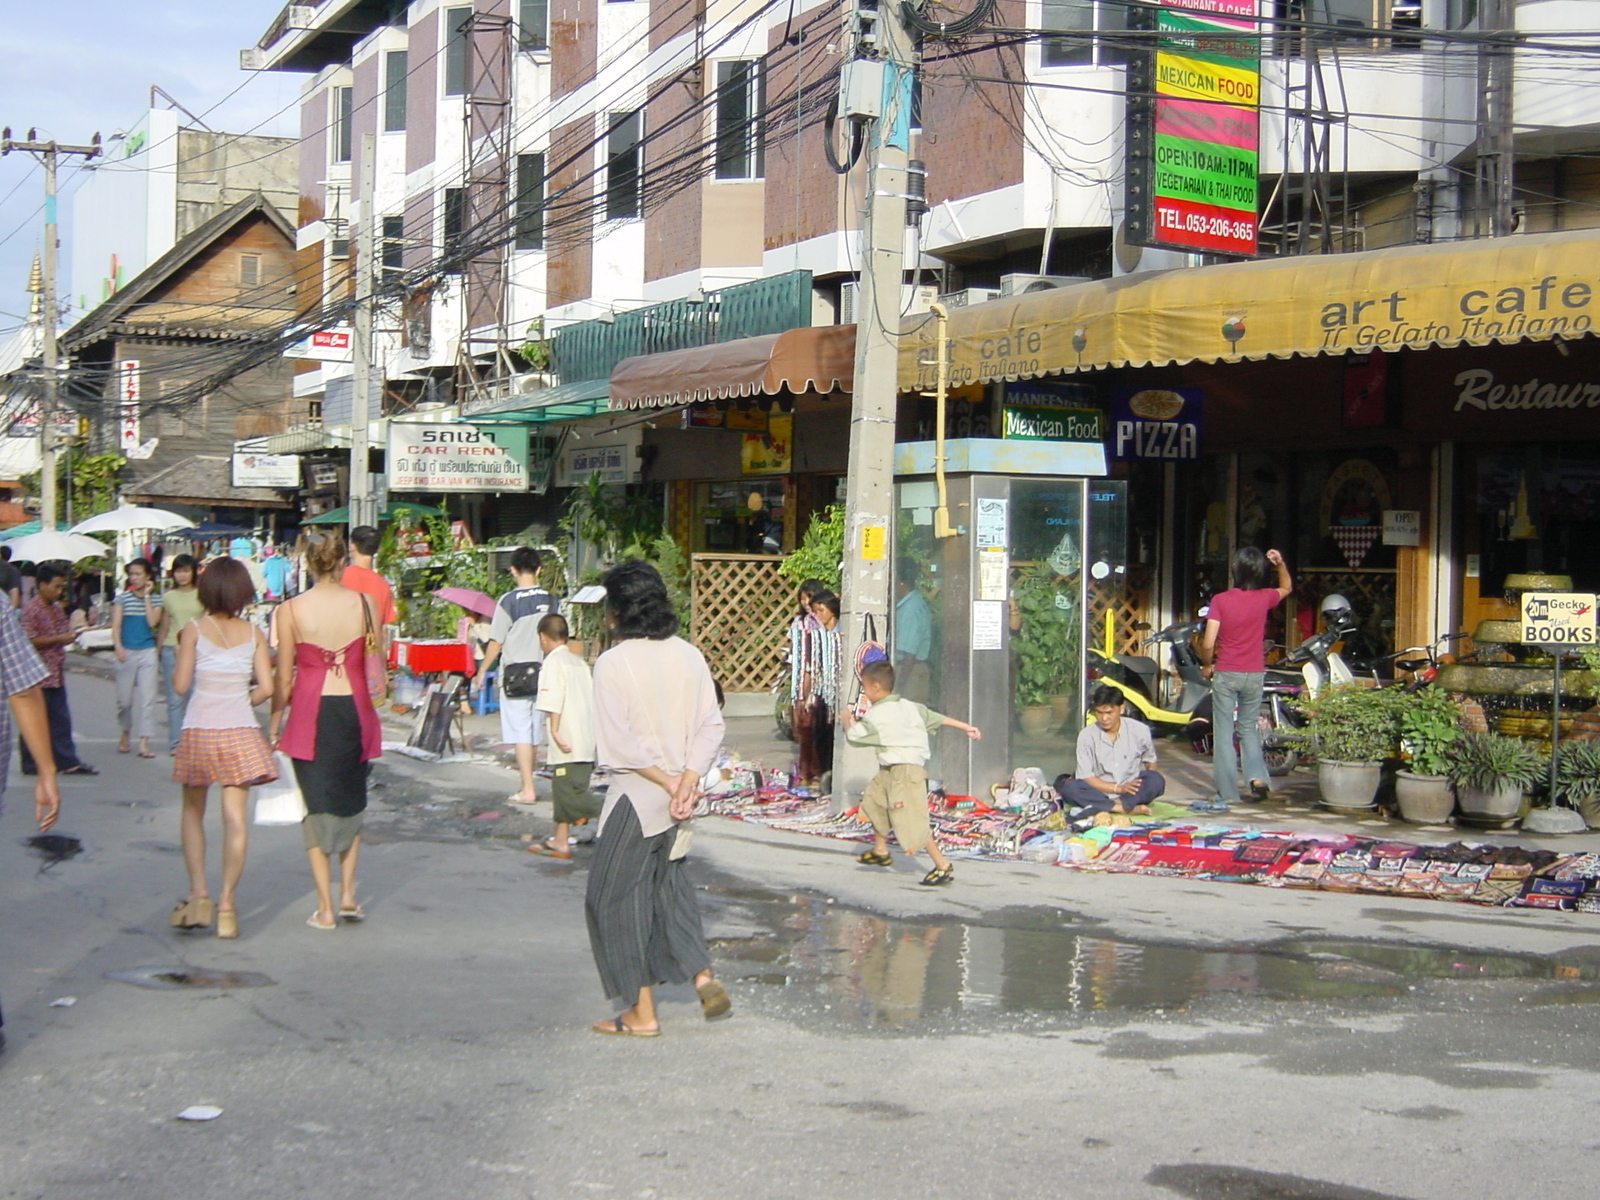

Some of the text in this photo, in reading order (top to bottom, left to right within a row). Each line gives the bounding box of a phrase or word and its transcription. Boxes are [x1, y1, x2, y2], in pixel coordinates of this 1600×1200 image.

[1160, 65, 1253, 99] MEXICAN FOOD
[1157, 172, 1254, 203] VEGETARIAN & THAI FOOD
[1320, 291, 1407, 327] art
[1323, 313, 1592, 349] Il Gelato Italiano
[931, 364, 972, 381] Glato
[979, 358, 1039, 378] Italiano
[1453, 368, 1600, 412] Restaur
[422, 427, 496, 443] รถเช่า
[1007, 411, 1064, 438] Mexican
[1067, 415, 1100, 439] Food
[407, 445, 510, 456] CAR RENT
[1116, 420, 1197, 459] PIZZA
[1550, 599, 1585, 609] Gecko
[1525, 626, 1592, 642] BOOKS
[1548, 616, 1571, 628] Used
